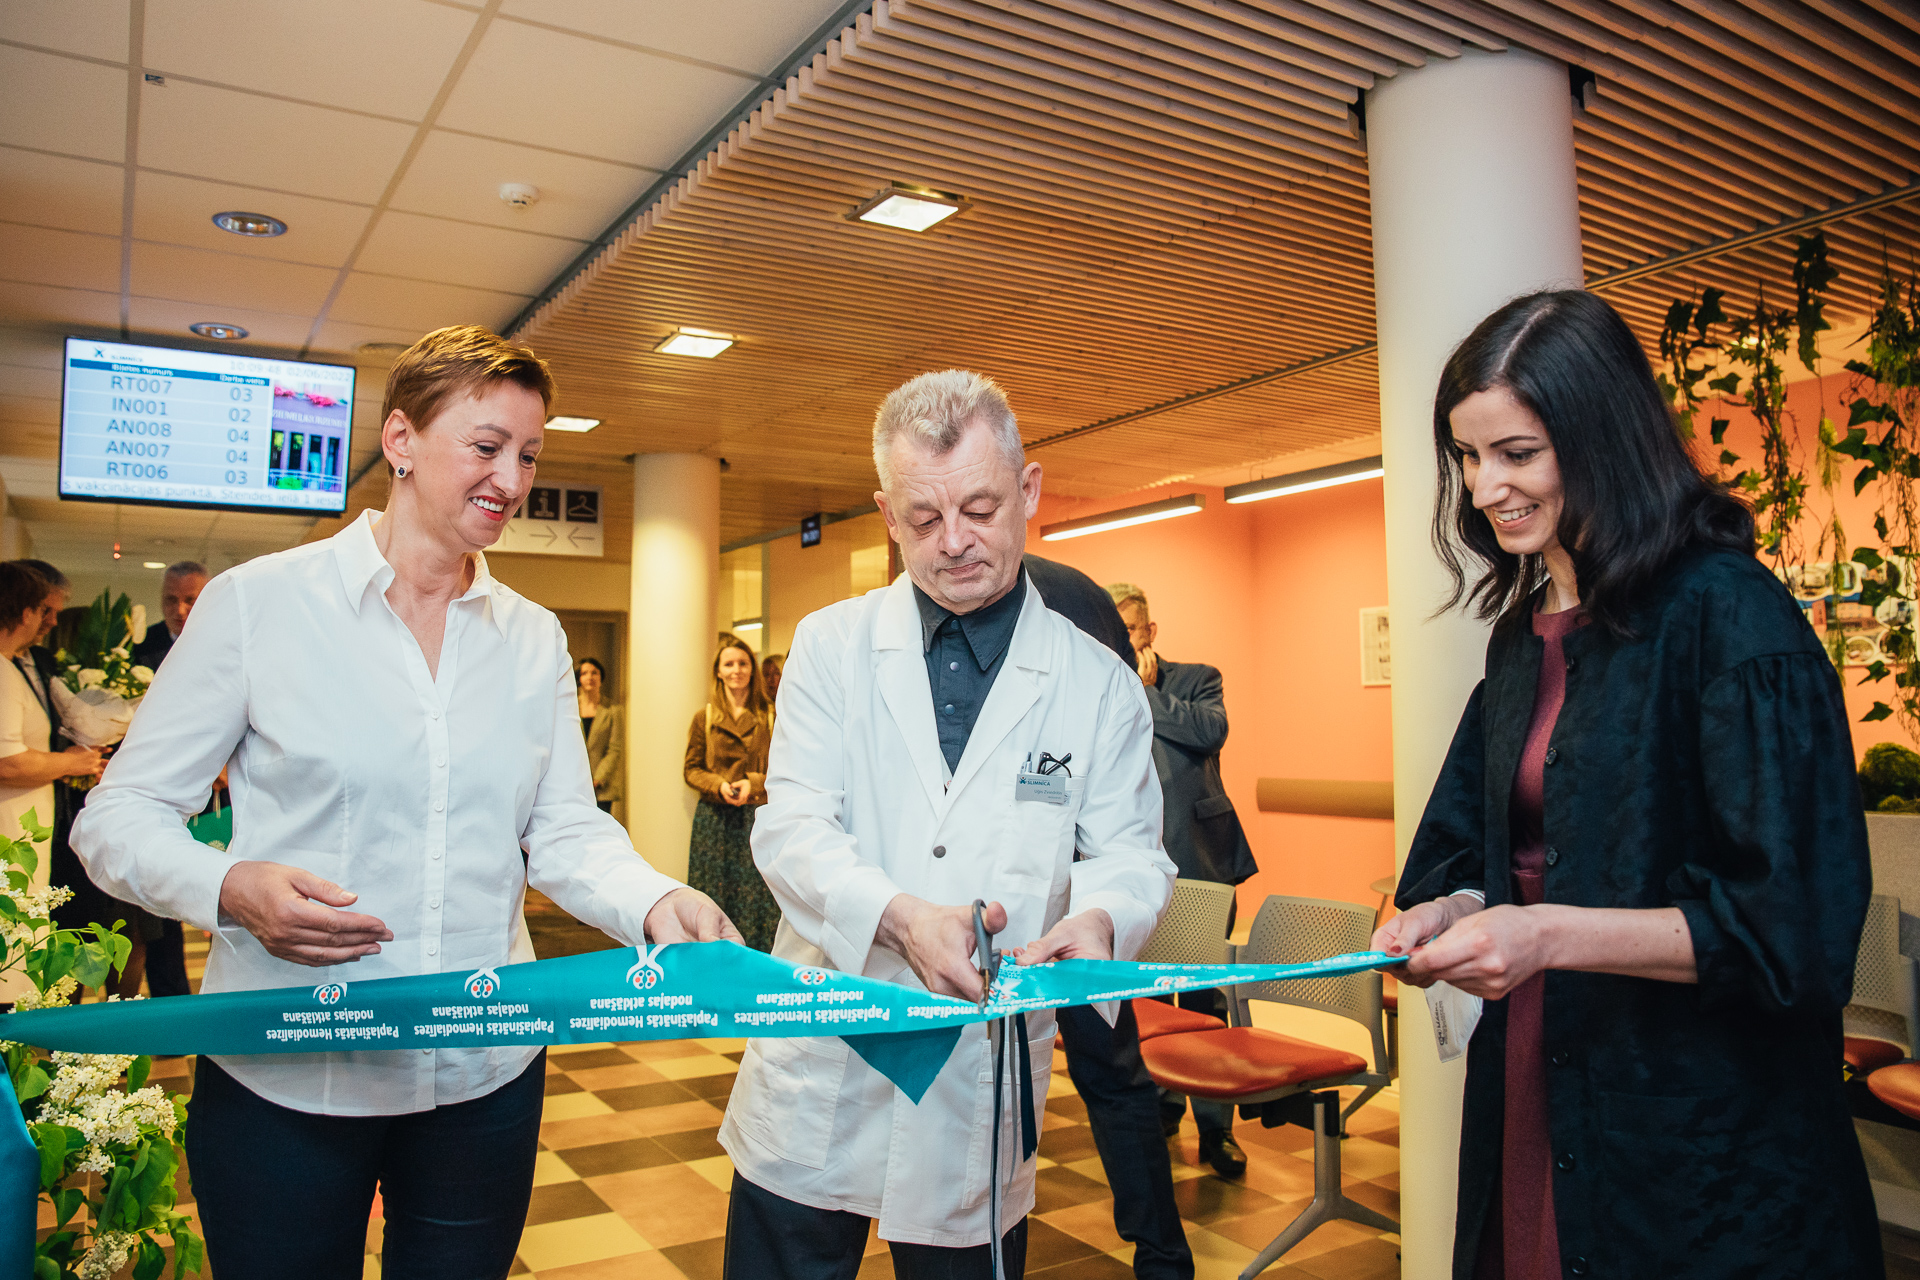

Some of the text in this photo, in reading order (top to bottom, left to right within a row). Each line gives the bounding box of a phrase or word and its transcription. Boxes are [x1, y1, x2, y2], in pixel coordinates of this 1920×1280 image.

[110, 375, 254, 403] RT007 03
[111, 397, 169, 416] IN001
[228, 407, 252, 424] 02
[106, 419, 250, 444] AN008 04
[105, 441, 249, 464] AN007 04
[105, 461, 248, 486] RT006 03
[590, 992, 693, 1012] nodaļas atklāšana
[756, 988, 864, 1007] nodaļas atklāšana
[282, 1007, 375, 1025] nodaļas atklāšana
[431, 1001, 530, 1020] nodaļas atklāšana
[569, 1009, 719, 1031] Paplašinātās Hemodialīzes
[734, 1003, 891, 1026] Paplašinātās Hemodialīzes
[266, 1023, 400, 1042] Paplašinātās Hemodialīzes
[414, 1017, 555, 1038] Paplašinātās Hemodialīzes
